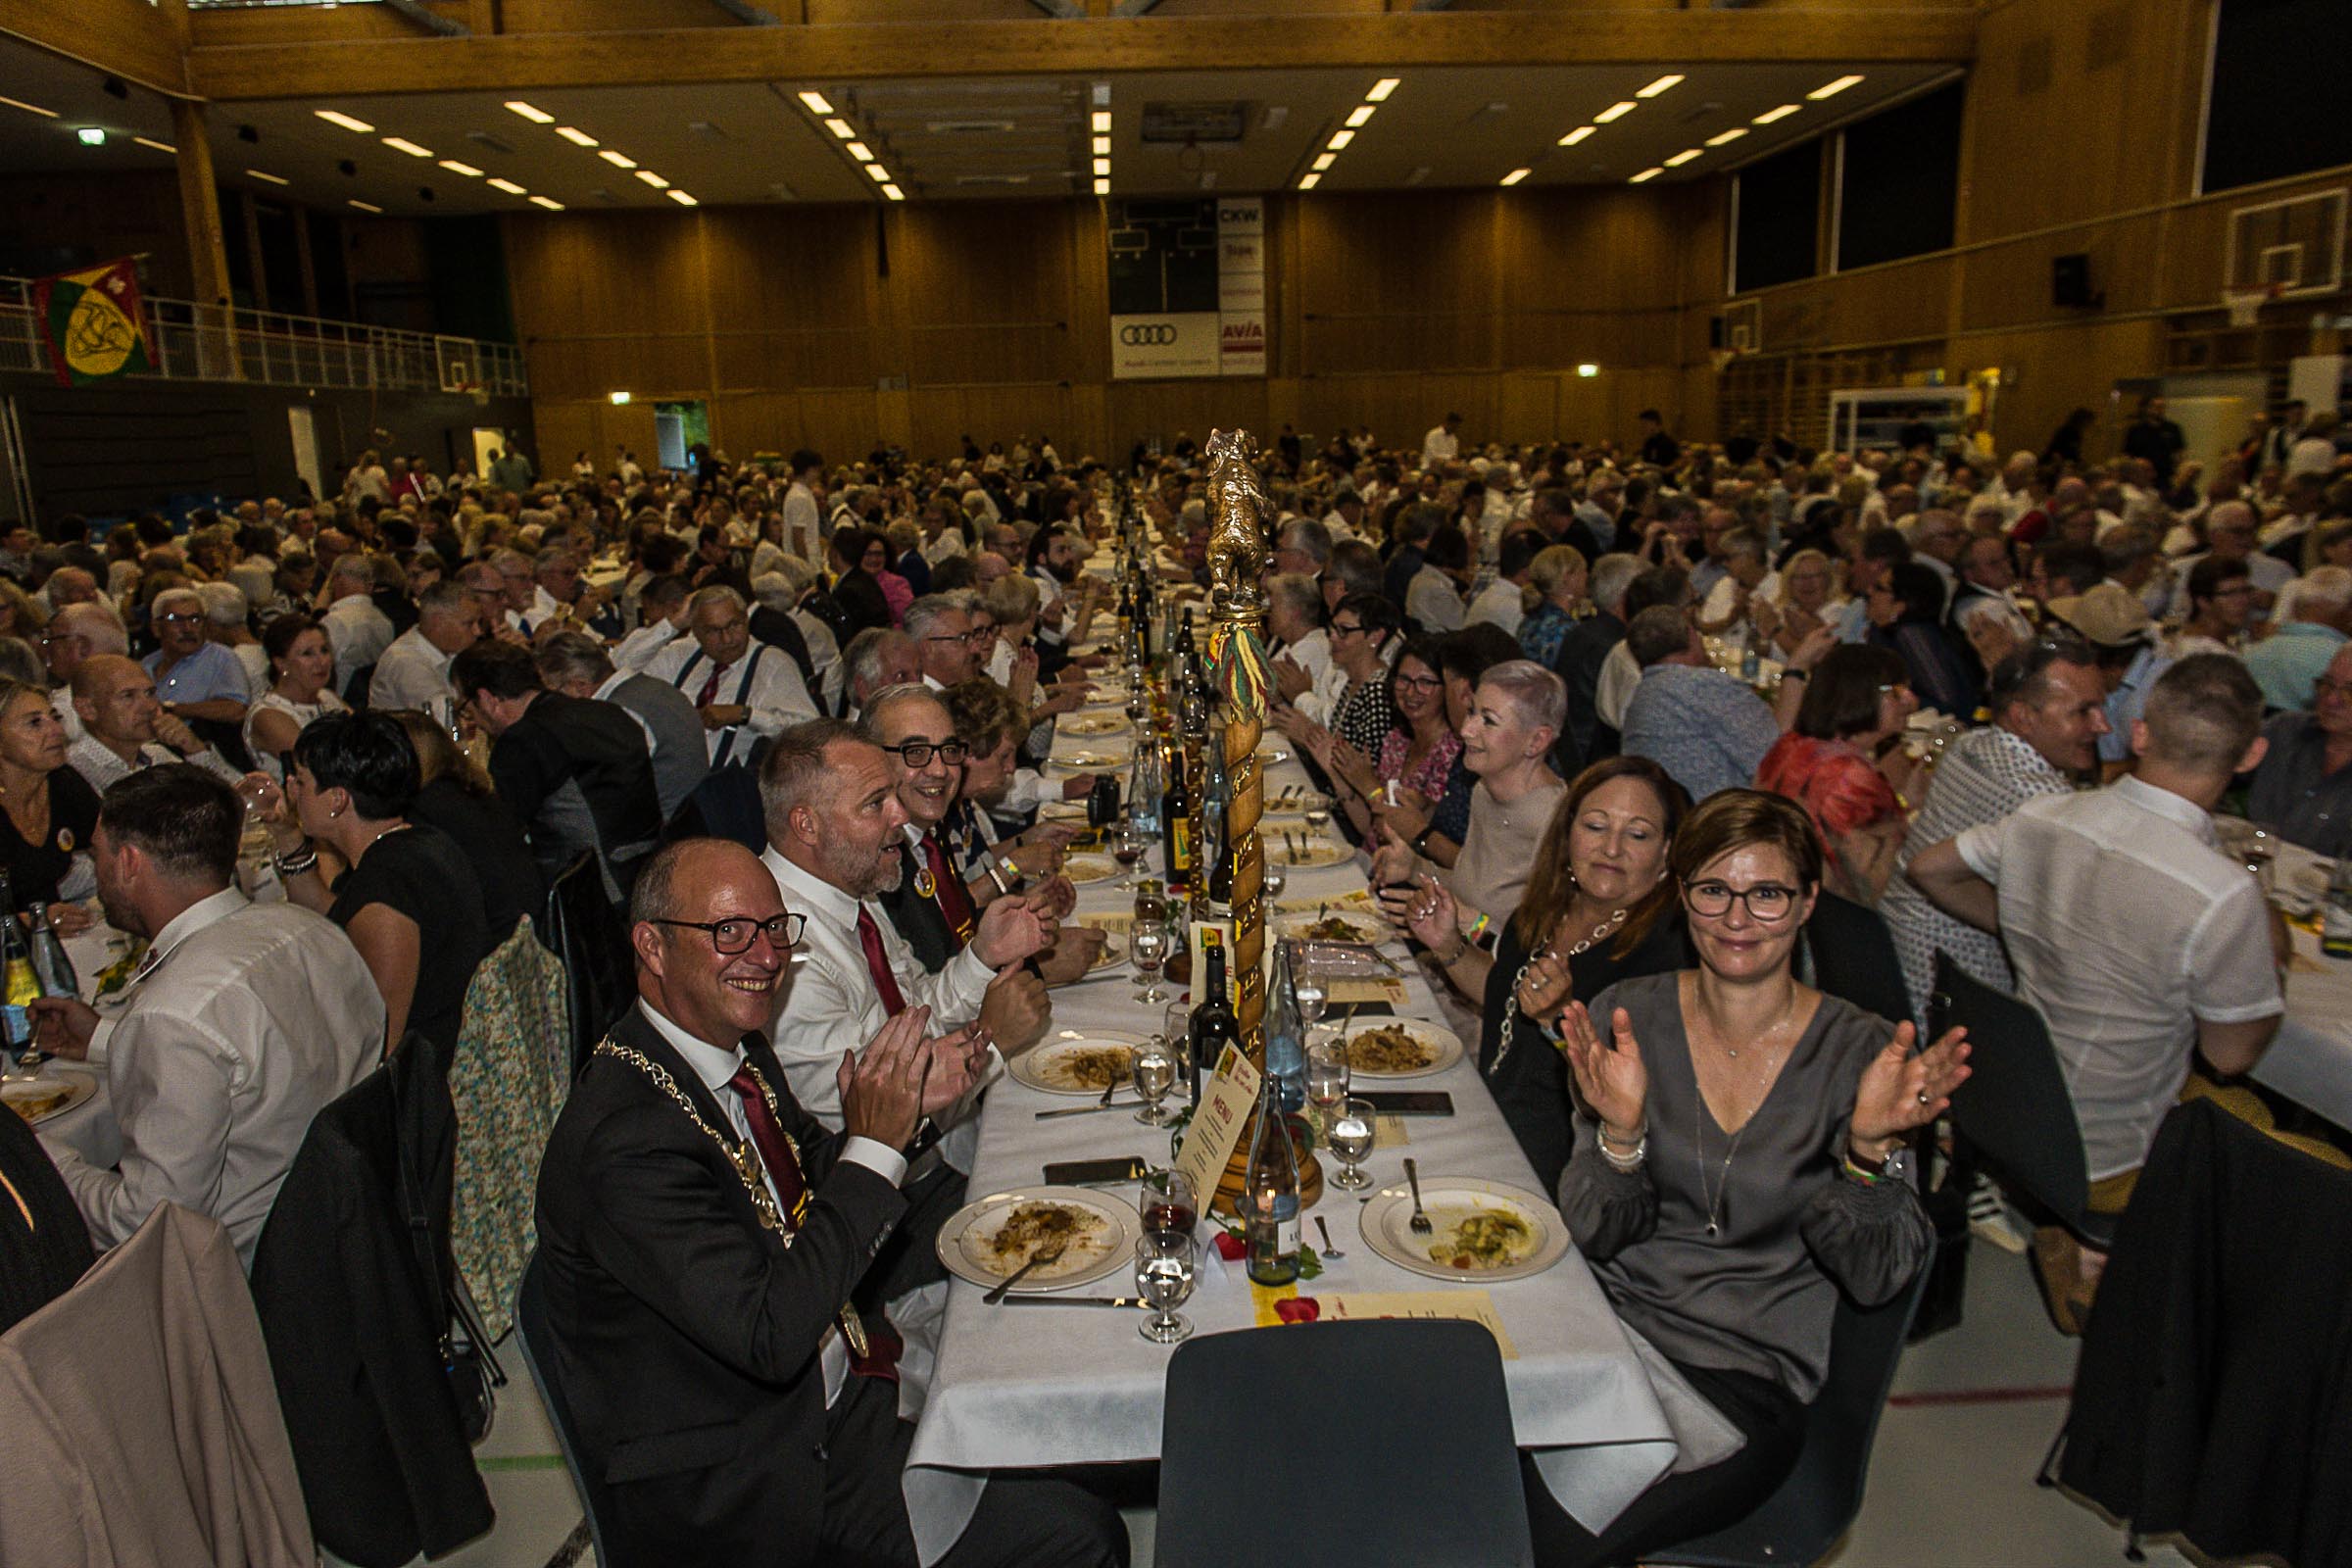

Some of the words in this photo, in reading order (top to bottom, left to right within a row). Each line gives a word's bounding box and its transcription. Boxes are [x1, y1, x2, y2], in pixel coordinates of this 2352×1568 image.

[1221, 208, 1257, 222] CKW
[1223, 321, 1262, 337] AVIA
[1212, 1094, 1234, 1125] MENU
